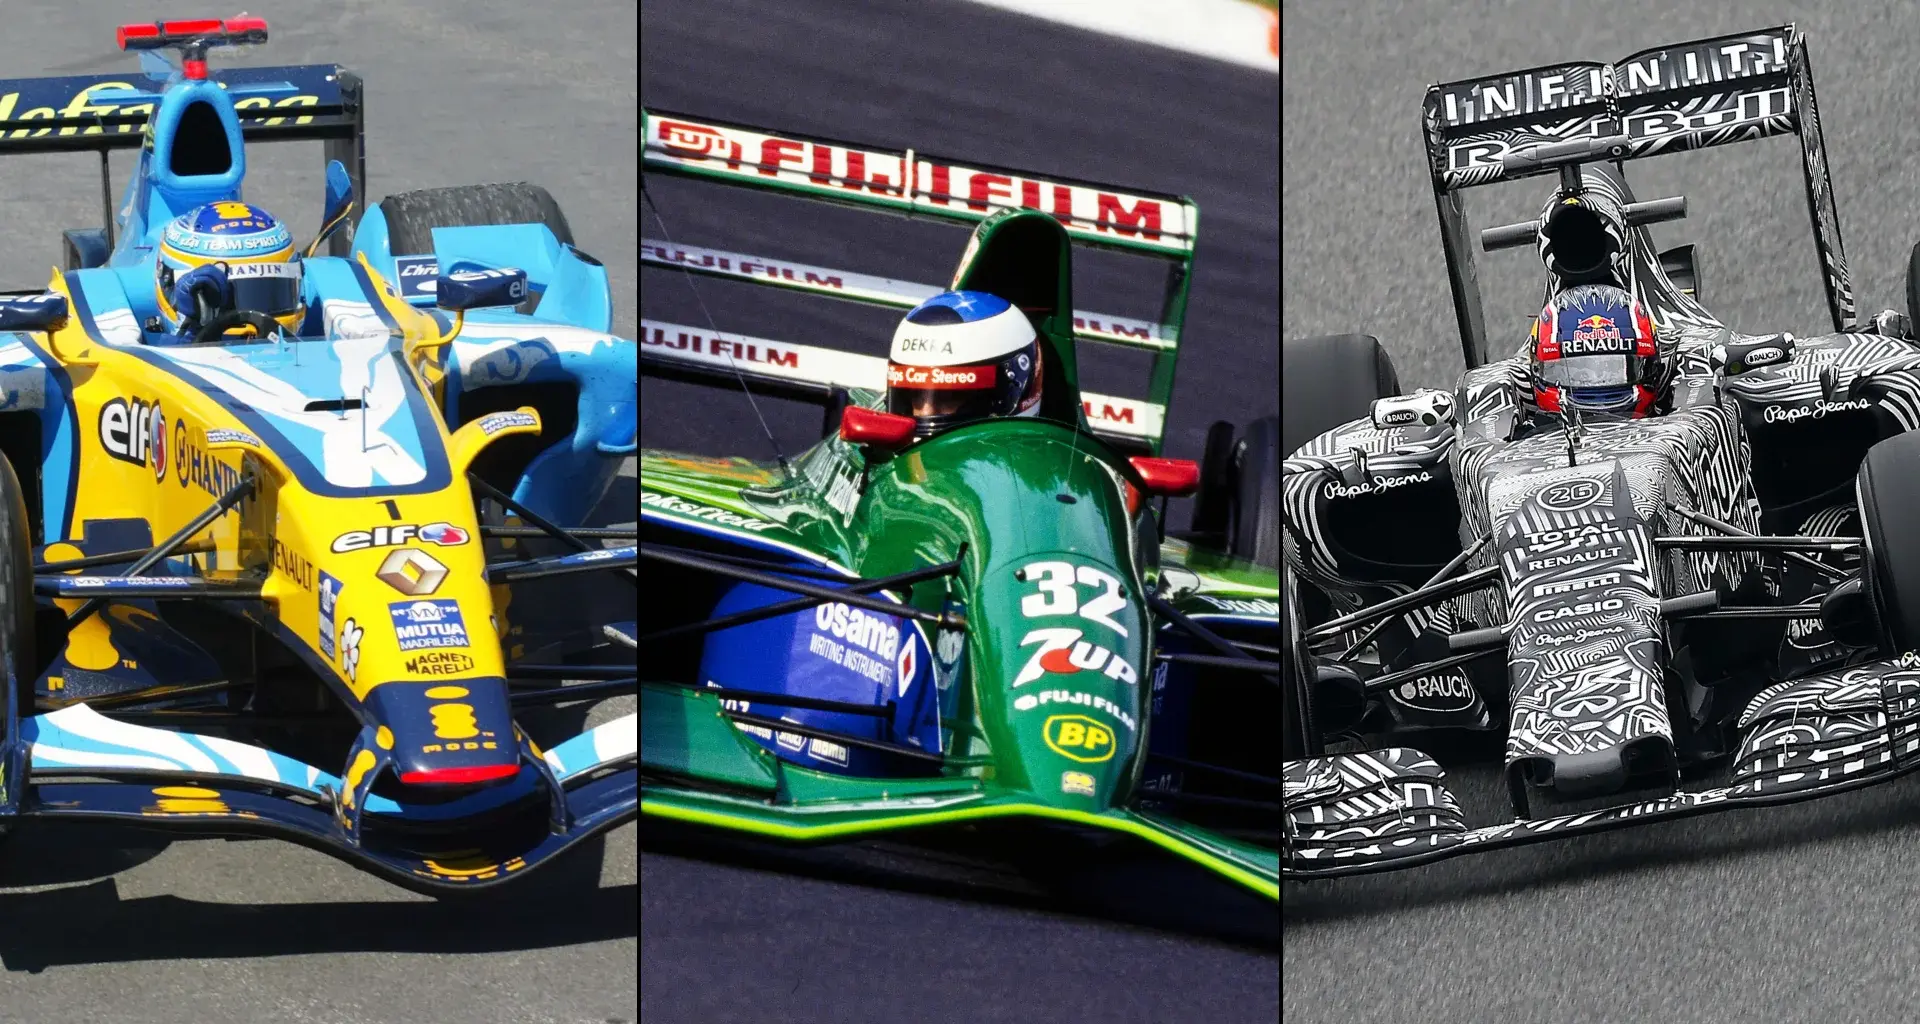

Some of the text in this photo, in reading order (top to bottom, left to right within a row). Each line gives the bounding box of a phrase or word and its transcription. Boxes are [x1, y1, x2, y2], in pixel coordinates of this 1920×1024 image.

[1444, 37, 1785, 122] INFINITI
[203, 239, 243, 250] TEAM
[245, 237, 278, 249] SPIRIT
[1574, 327, 1620, 340] Red Bull
[1562, 338, 1634, 354] RENAULT
[1753, 352, 1778, 362] RAUCH
[905, 367, 928, 383] Car
[931, 368, 976, 384] Stereo
[1391, 412, 1415, 422] RAUCH
[1763, 398, 1871, 424] Pepe Jeans
[98, 395, 150, 468] elf
[1324, 471, 1433, 500] Pepe Jeans
[1549, 483, 1593, 505] 26
[376, 499, 402, 520] 1
[330, 524, 420, 554] elf
[1524, 522, 1619, 545] TOTAL
[268, 533, 312, 593] RENAULT
[1529, 547, 1622, 571] RENAULT
[1533, 572, 1621, 598] PIRELLI
[1021, 561, 1128, 638] 32
[1534, 598, 1624, 623] CASIO
[397, 623, 466, 639] MUTUA
[401, 635, 468, 650] MADRILEÑA
[816, 602, 899, 661] osama
[1535, 626, 1625, 646] Pepe Jeans
[810, 633, 893, 687] WRITING INSTRUMENTS
[1416, 675, 1471, 699] RAUCH
[422, 741, 498, 754] MODE
[1057, 721, 1110, 750] BP
